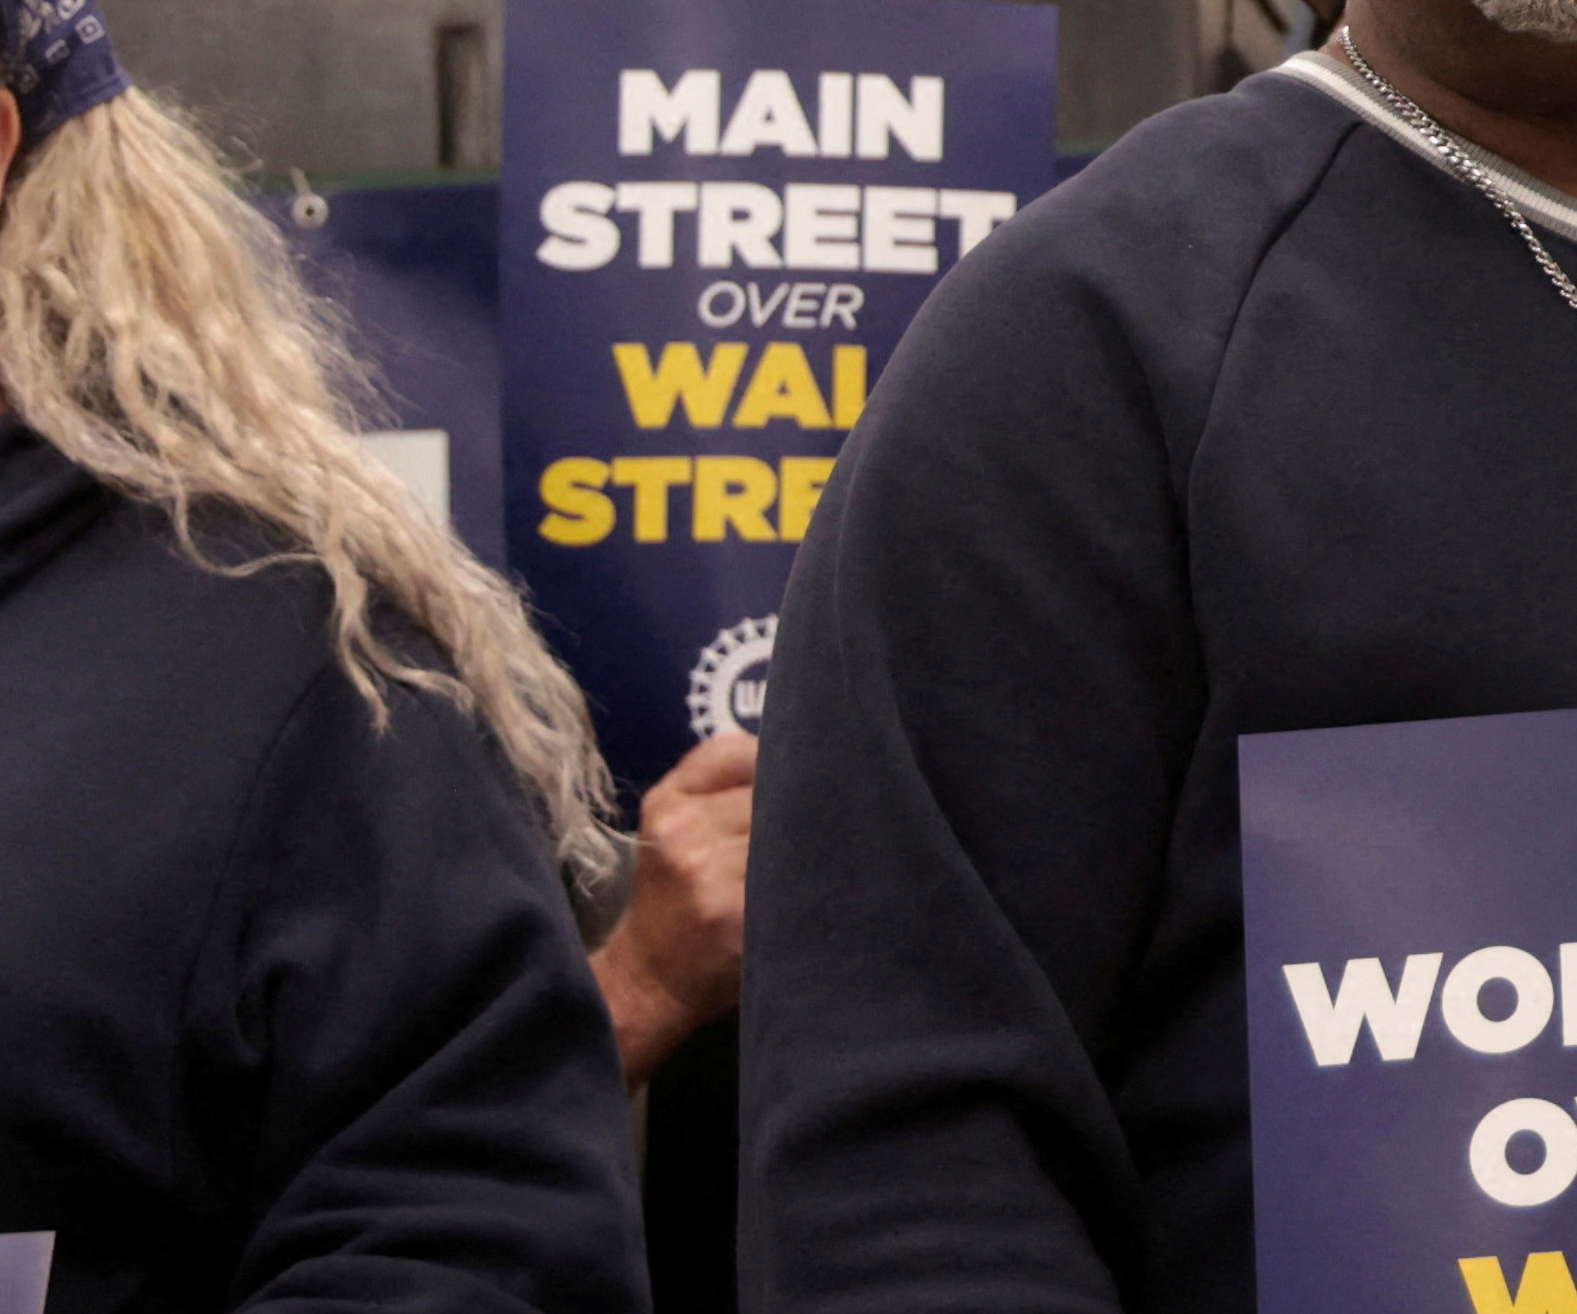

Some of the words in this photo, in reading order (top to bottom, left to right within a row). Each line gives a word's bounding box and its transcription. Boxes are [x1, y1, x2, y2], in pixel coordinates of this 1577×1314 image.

[617, 68, 946, 163] MAIN
[536, 180, 1018, 275] STREET
[697, 280, 865, 330] OVER
[612, 342, 869, 431] WAL
[537, 456, 828, 547] STRE
